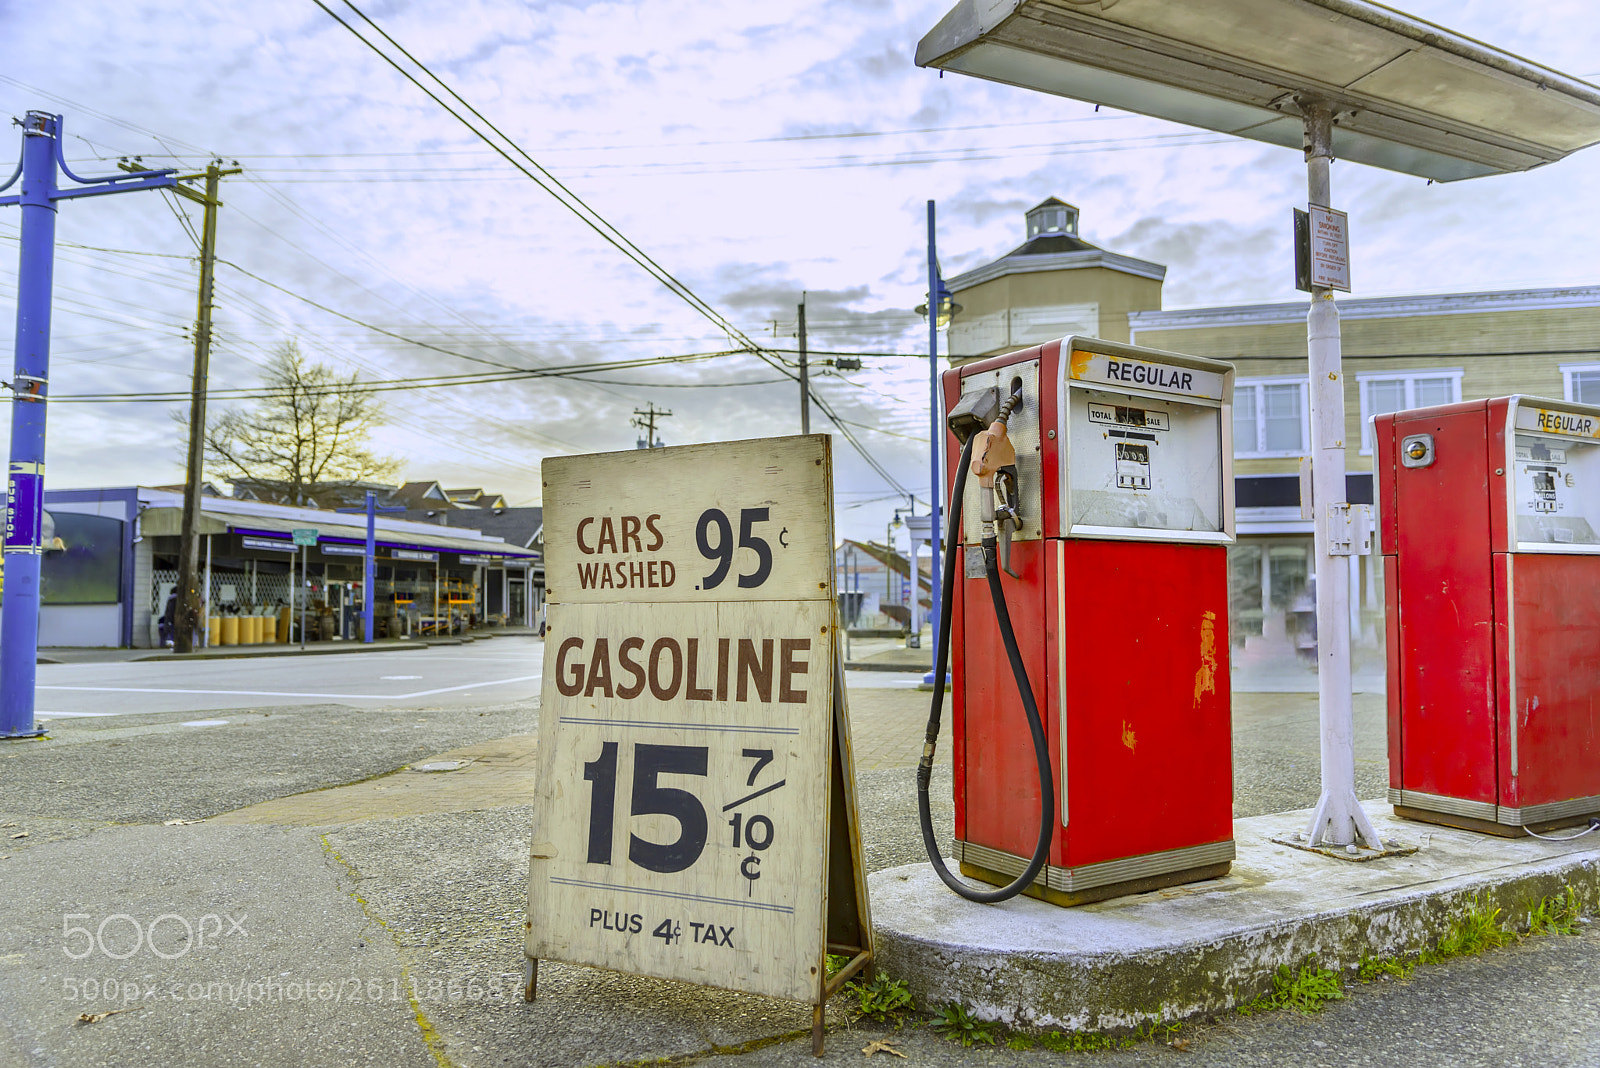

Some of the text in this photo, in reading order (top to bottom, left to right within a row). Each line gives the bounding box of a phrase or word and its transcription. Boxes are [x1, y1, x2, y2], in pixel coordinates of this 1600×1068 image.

[1318, 221, 1341, 232] SMOKING
[1325, 215, 1334, 223] NO
[1106, 360, 1193, 391] REGULAR
[1091, 410, 1112, 420] TOTAL
[1147, 417, 1161, 426] SALE
[1537, 413, 1592, 434] REGULAR
[6, 480, 16, 540] BUS STOP
[576, 513, 664, 555] CARS
[577, 560, 677, 590] WASHED
[555, 636, 812, 704] GASOLINE
[583, 741, 709, 874] 15
[589, 907, 644, 934] PLUS
[689, 921, 736, 949] TAX
